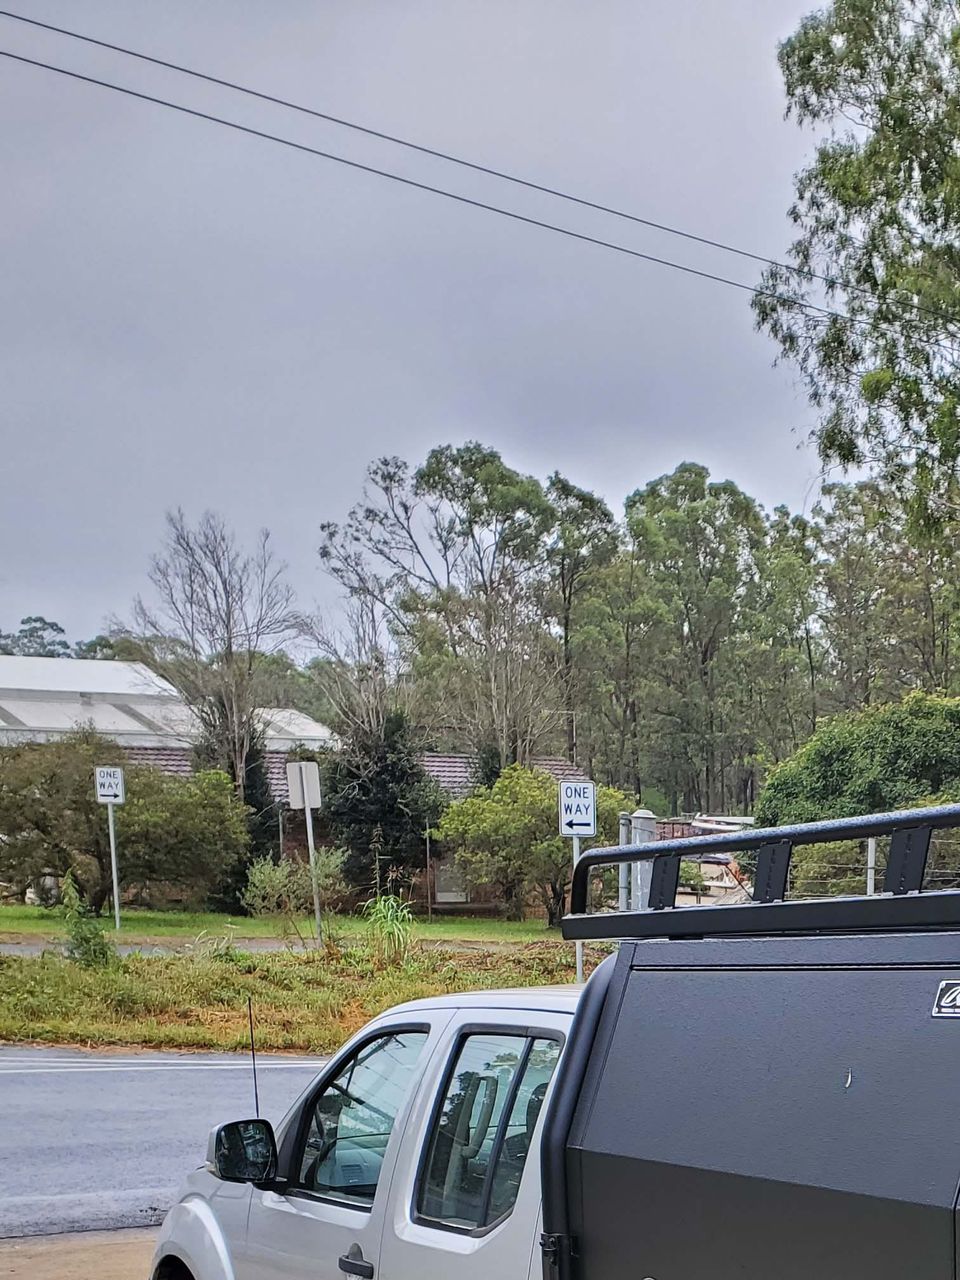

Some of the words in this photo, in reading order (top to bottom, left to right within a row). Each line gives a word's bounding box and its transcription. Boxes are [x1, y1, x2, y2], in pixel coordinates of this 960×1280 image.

[99, 770, 118, 779] ONE
[99, 781, 119, 790] WAY
[565, 786, 590, 799] ONE
[563, 803, 591, 816] WAY
